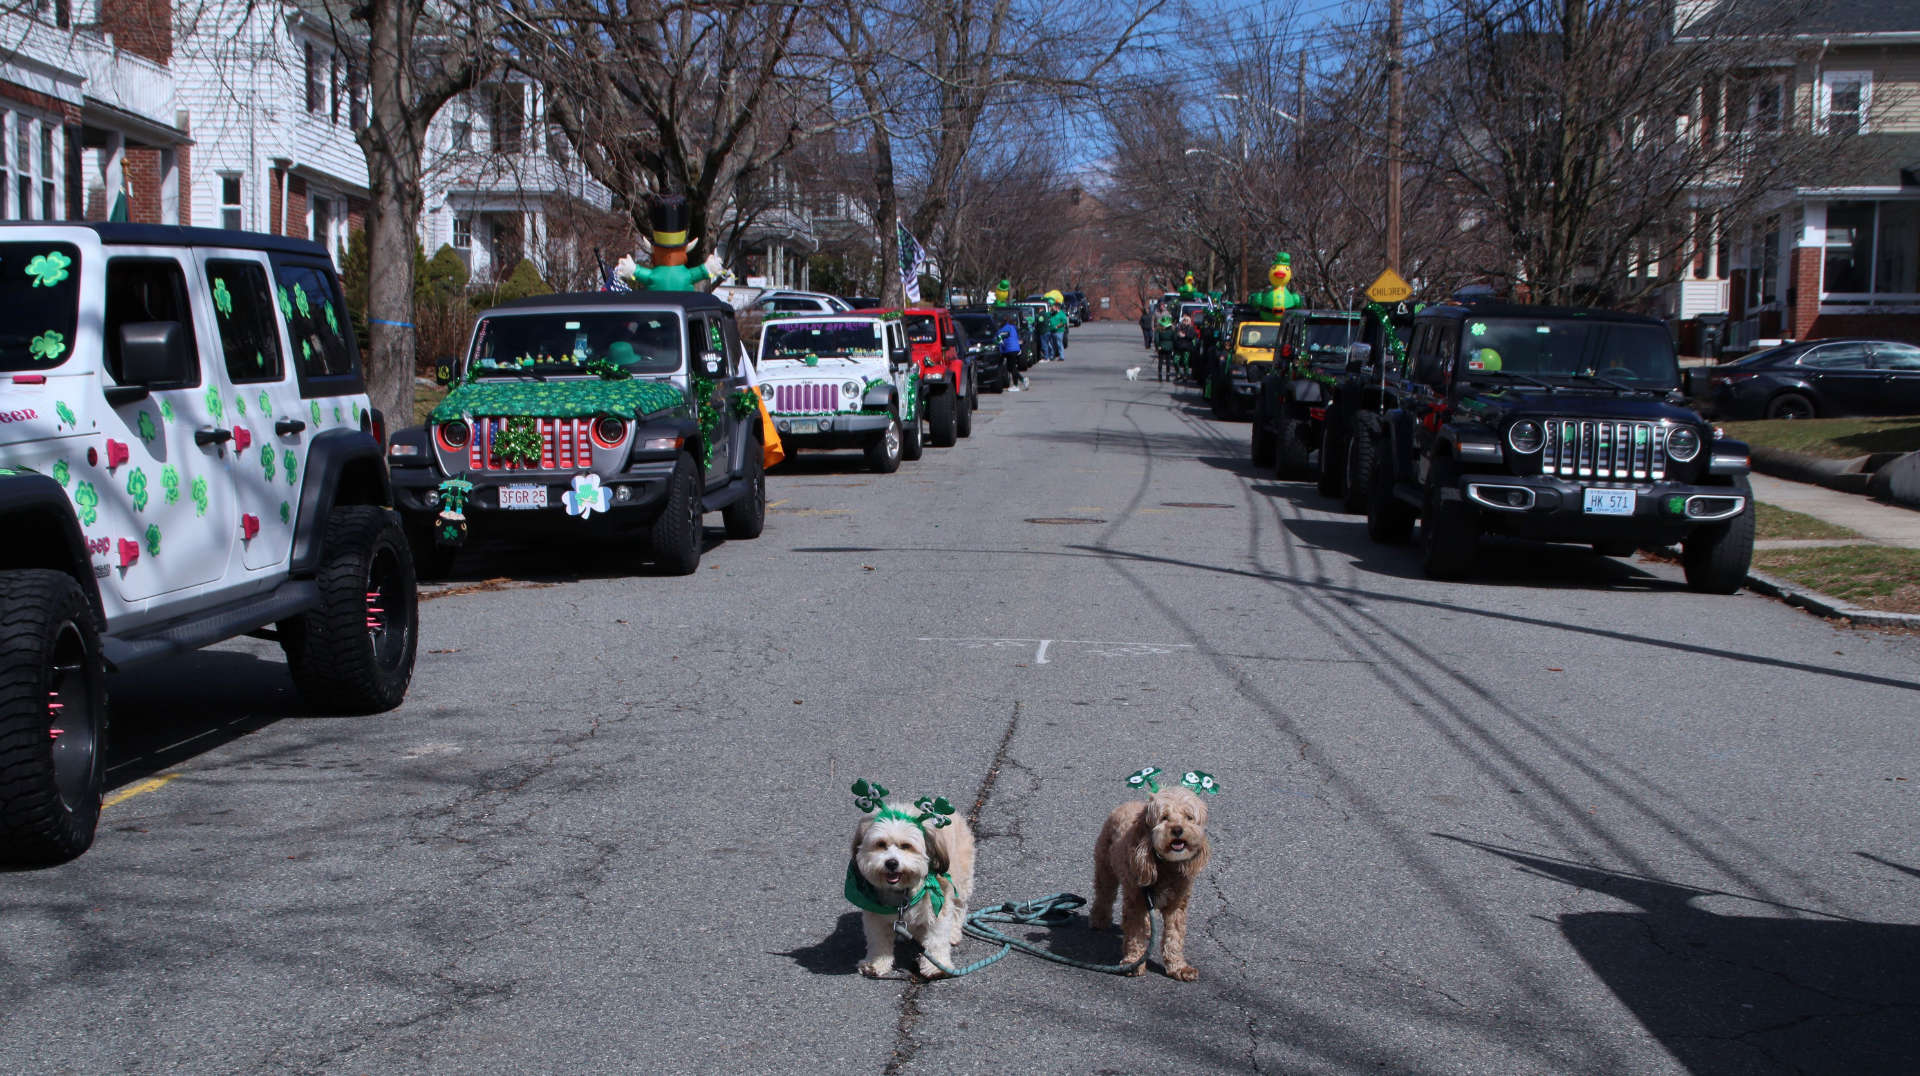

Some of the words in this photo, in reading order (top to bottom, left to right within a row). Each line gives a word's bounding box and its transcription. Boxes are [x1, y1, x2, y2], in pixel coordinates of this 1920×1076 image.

[1371, 287, 1407, 297] CHILDREN
[0, 408, 39, 424] een
[501, 490, 529, 504] 3FGR
[532, 490, 546, 503] 25
[1591, 495, 1604, 507] HK
[1610, 495, 1628, 508] 571
